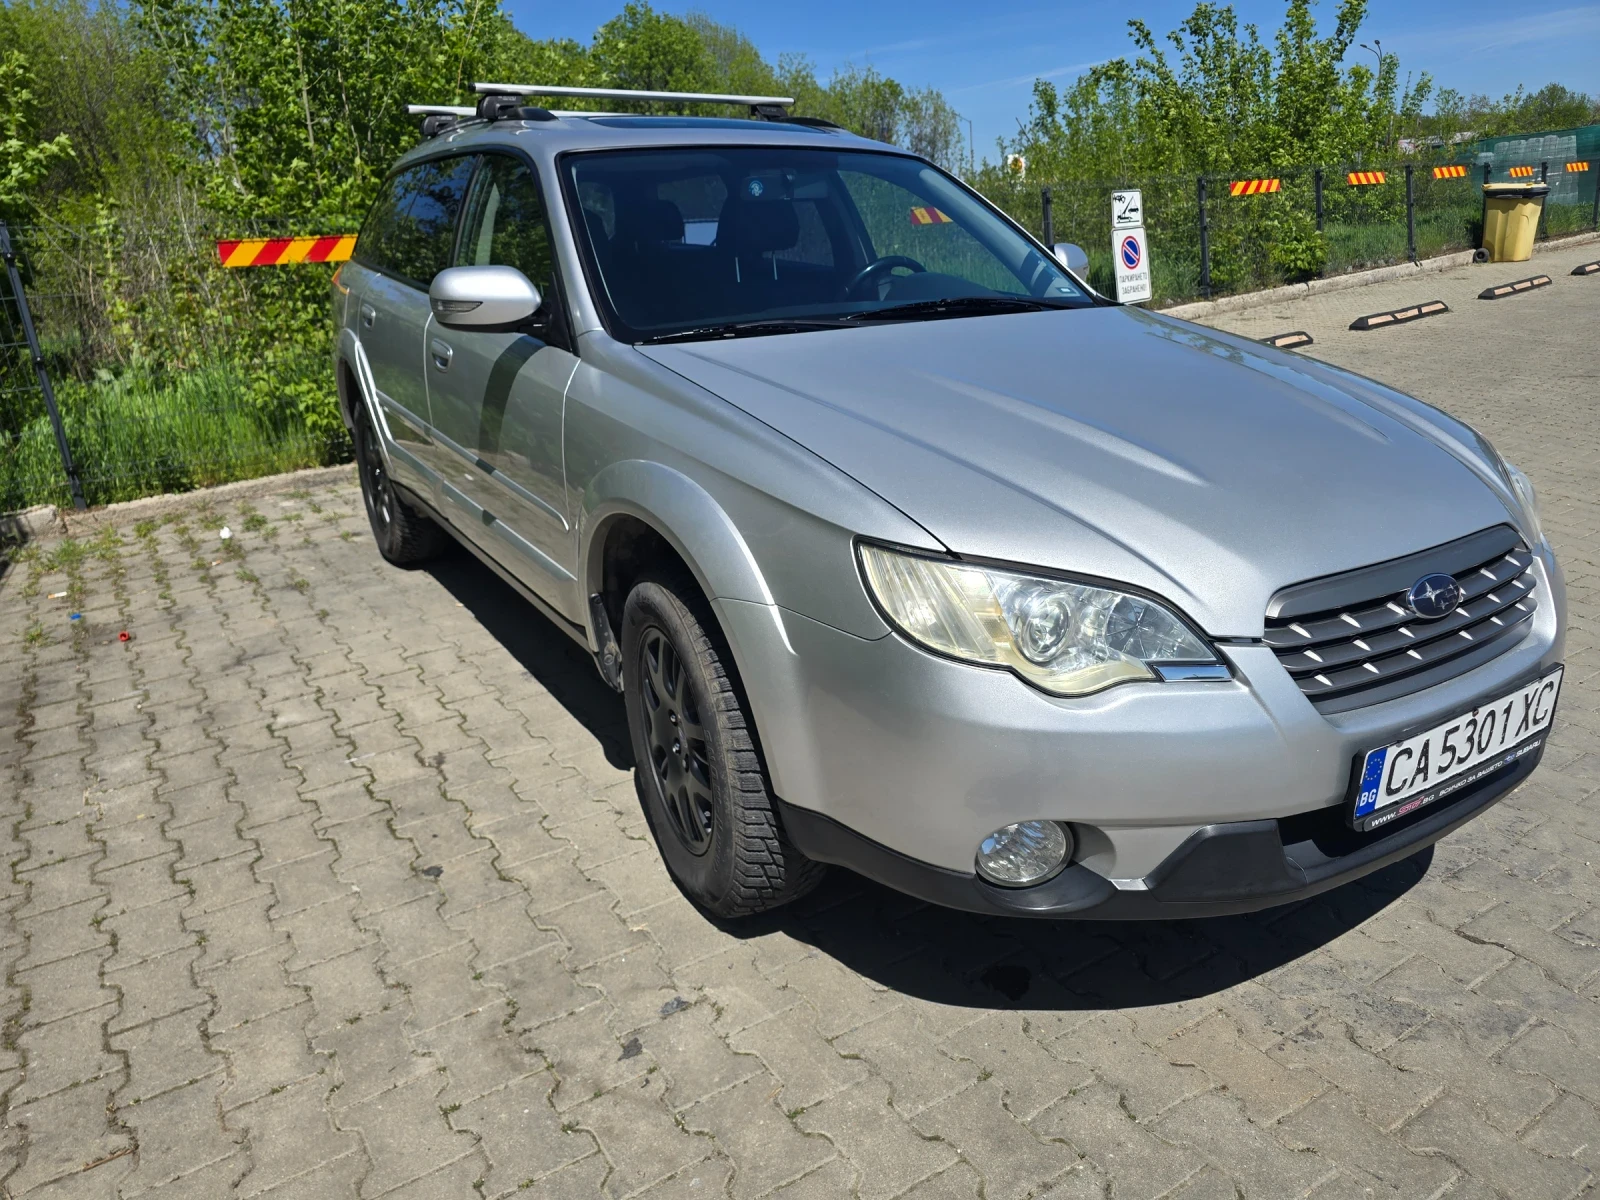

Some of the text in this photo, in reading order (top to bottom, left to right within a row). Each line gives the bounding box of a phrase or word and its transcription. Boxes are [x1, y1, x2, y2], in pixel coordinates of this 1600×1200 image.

[1119, 272, 1147, 283] ПАРКИРАНЕТО
[1467, 774, 1476, 784] ЗА
[1515, 739, 1542, 758] SUBARU
[1359, 788, 1377, 807] BG
